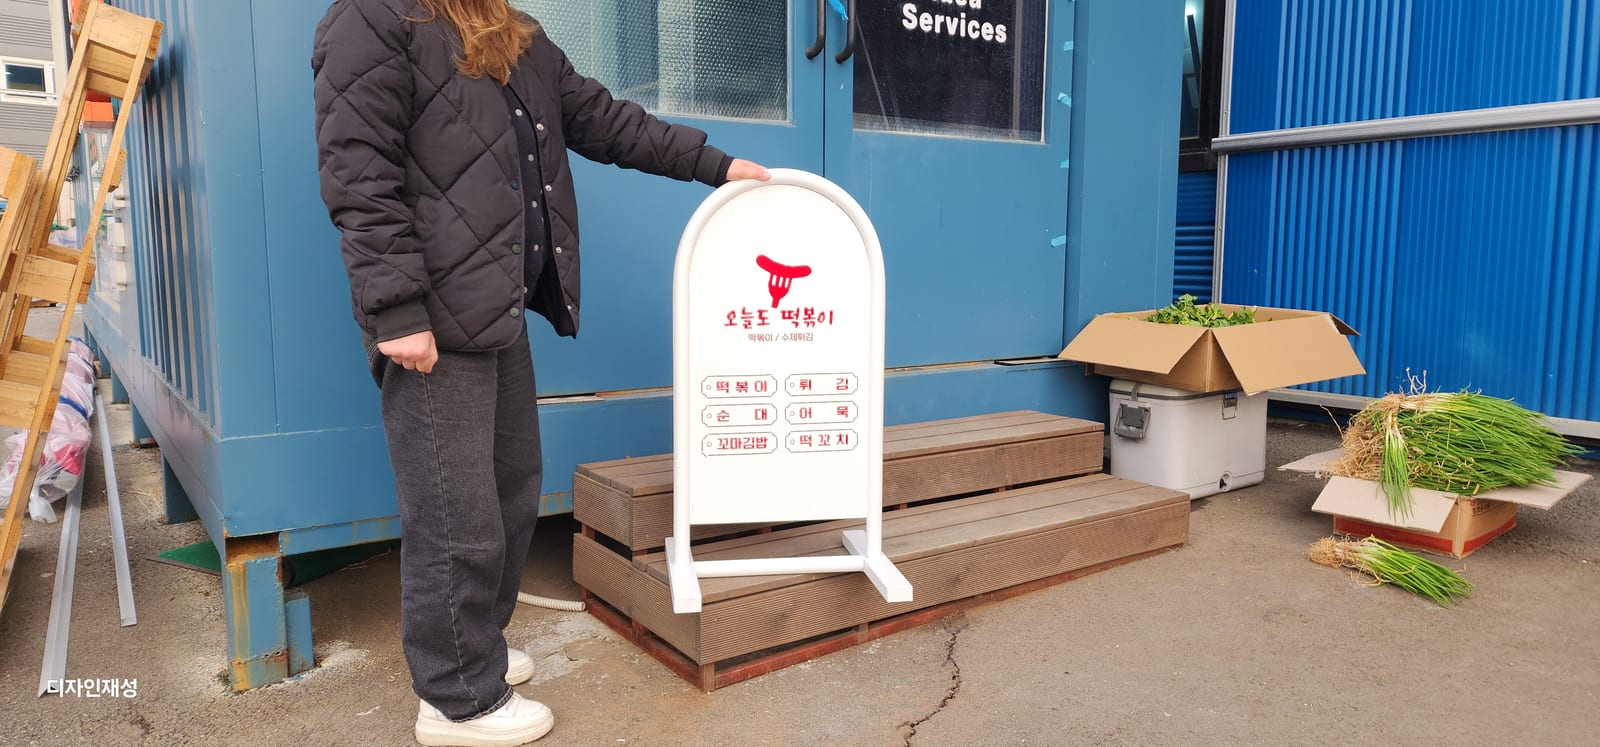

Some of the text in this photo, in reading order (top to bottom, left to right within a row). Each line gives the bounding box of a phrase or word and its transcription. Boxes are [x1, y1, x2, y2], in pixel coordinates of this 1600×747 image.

[902, 3, 1007, 43] Services
[724, 306, 833, 329] 오늘도 떡볶이
[748, 333, 773, 342] 떡볶이
[781, 332, 814, 342] 수제튀김
[716, 380, 768, 393] 떡볶이
[716, 436, 769, 450] 꼬마김밥
[799, 433, 849, 447] 떡꼬치
